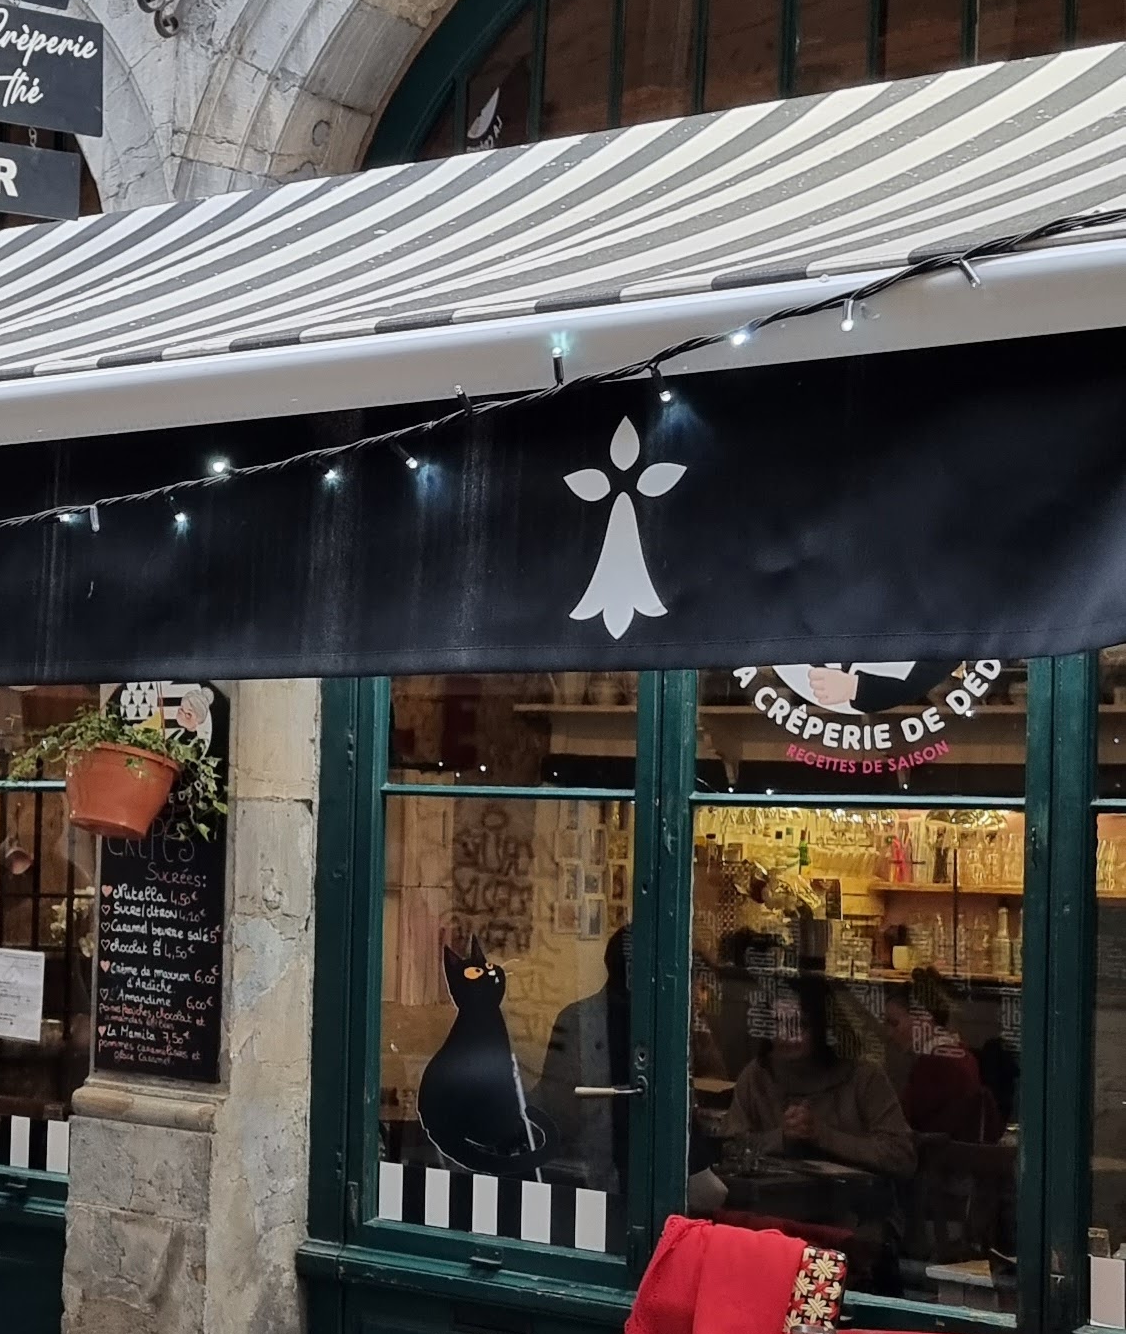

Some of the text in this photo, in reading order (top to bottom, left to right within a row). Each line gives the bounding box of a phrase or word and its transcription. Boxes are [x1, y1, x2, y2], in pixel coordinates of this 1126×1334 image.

[732, 659, 1002, 750] A CRÊPERIE DE DÉD
[786, 740, 949, 774] RECETTES DE SAISON
[113, 883, 167, 902] Nutella
[110, 919, 148, 934] Caramel
[151, 921, 184, 939] beurre
[187, 927, 210, 942] salé
[110, 962, 138, 976] Crème
[141, 964, 151, 976] de
[154, 969, 191, 982] marron
